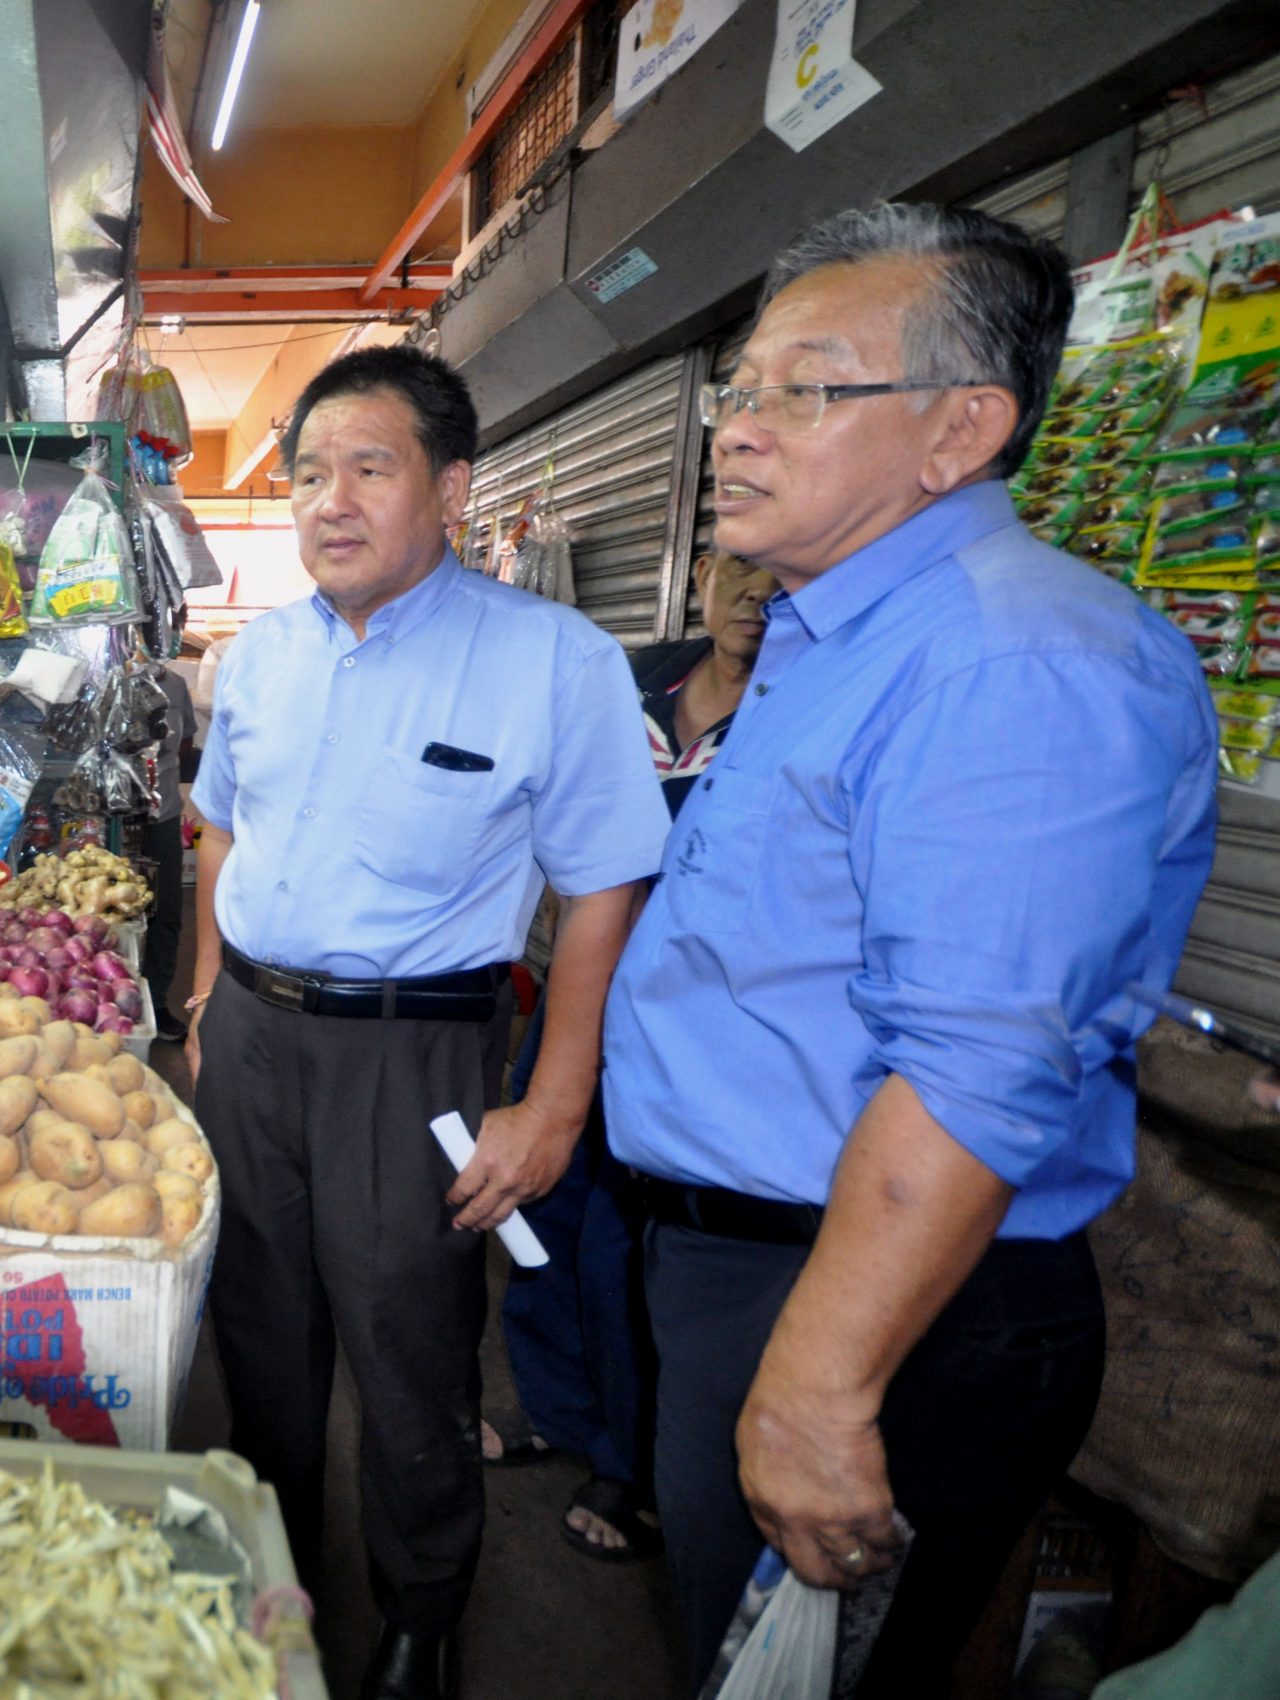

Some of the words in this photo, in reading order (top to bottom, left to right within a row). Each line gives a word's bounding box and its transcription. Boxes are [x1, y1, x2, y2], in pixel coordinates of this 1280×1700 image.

[19, 1287, 60, 1301] POTATO
[96, 1287, 132, 1301] BENCH
[30, 1373, 132, 1410] Pride
